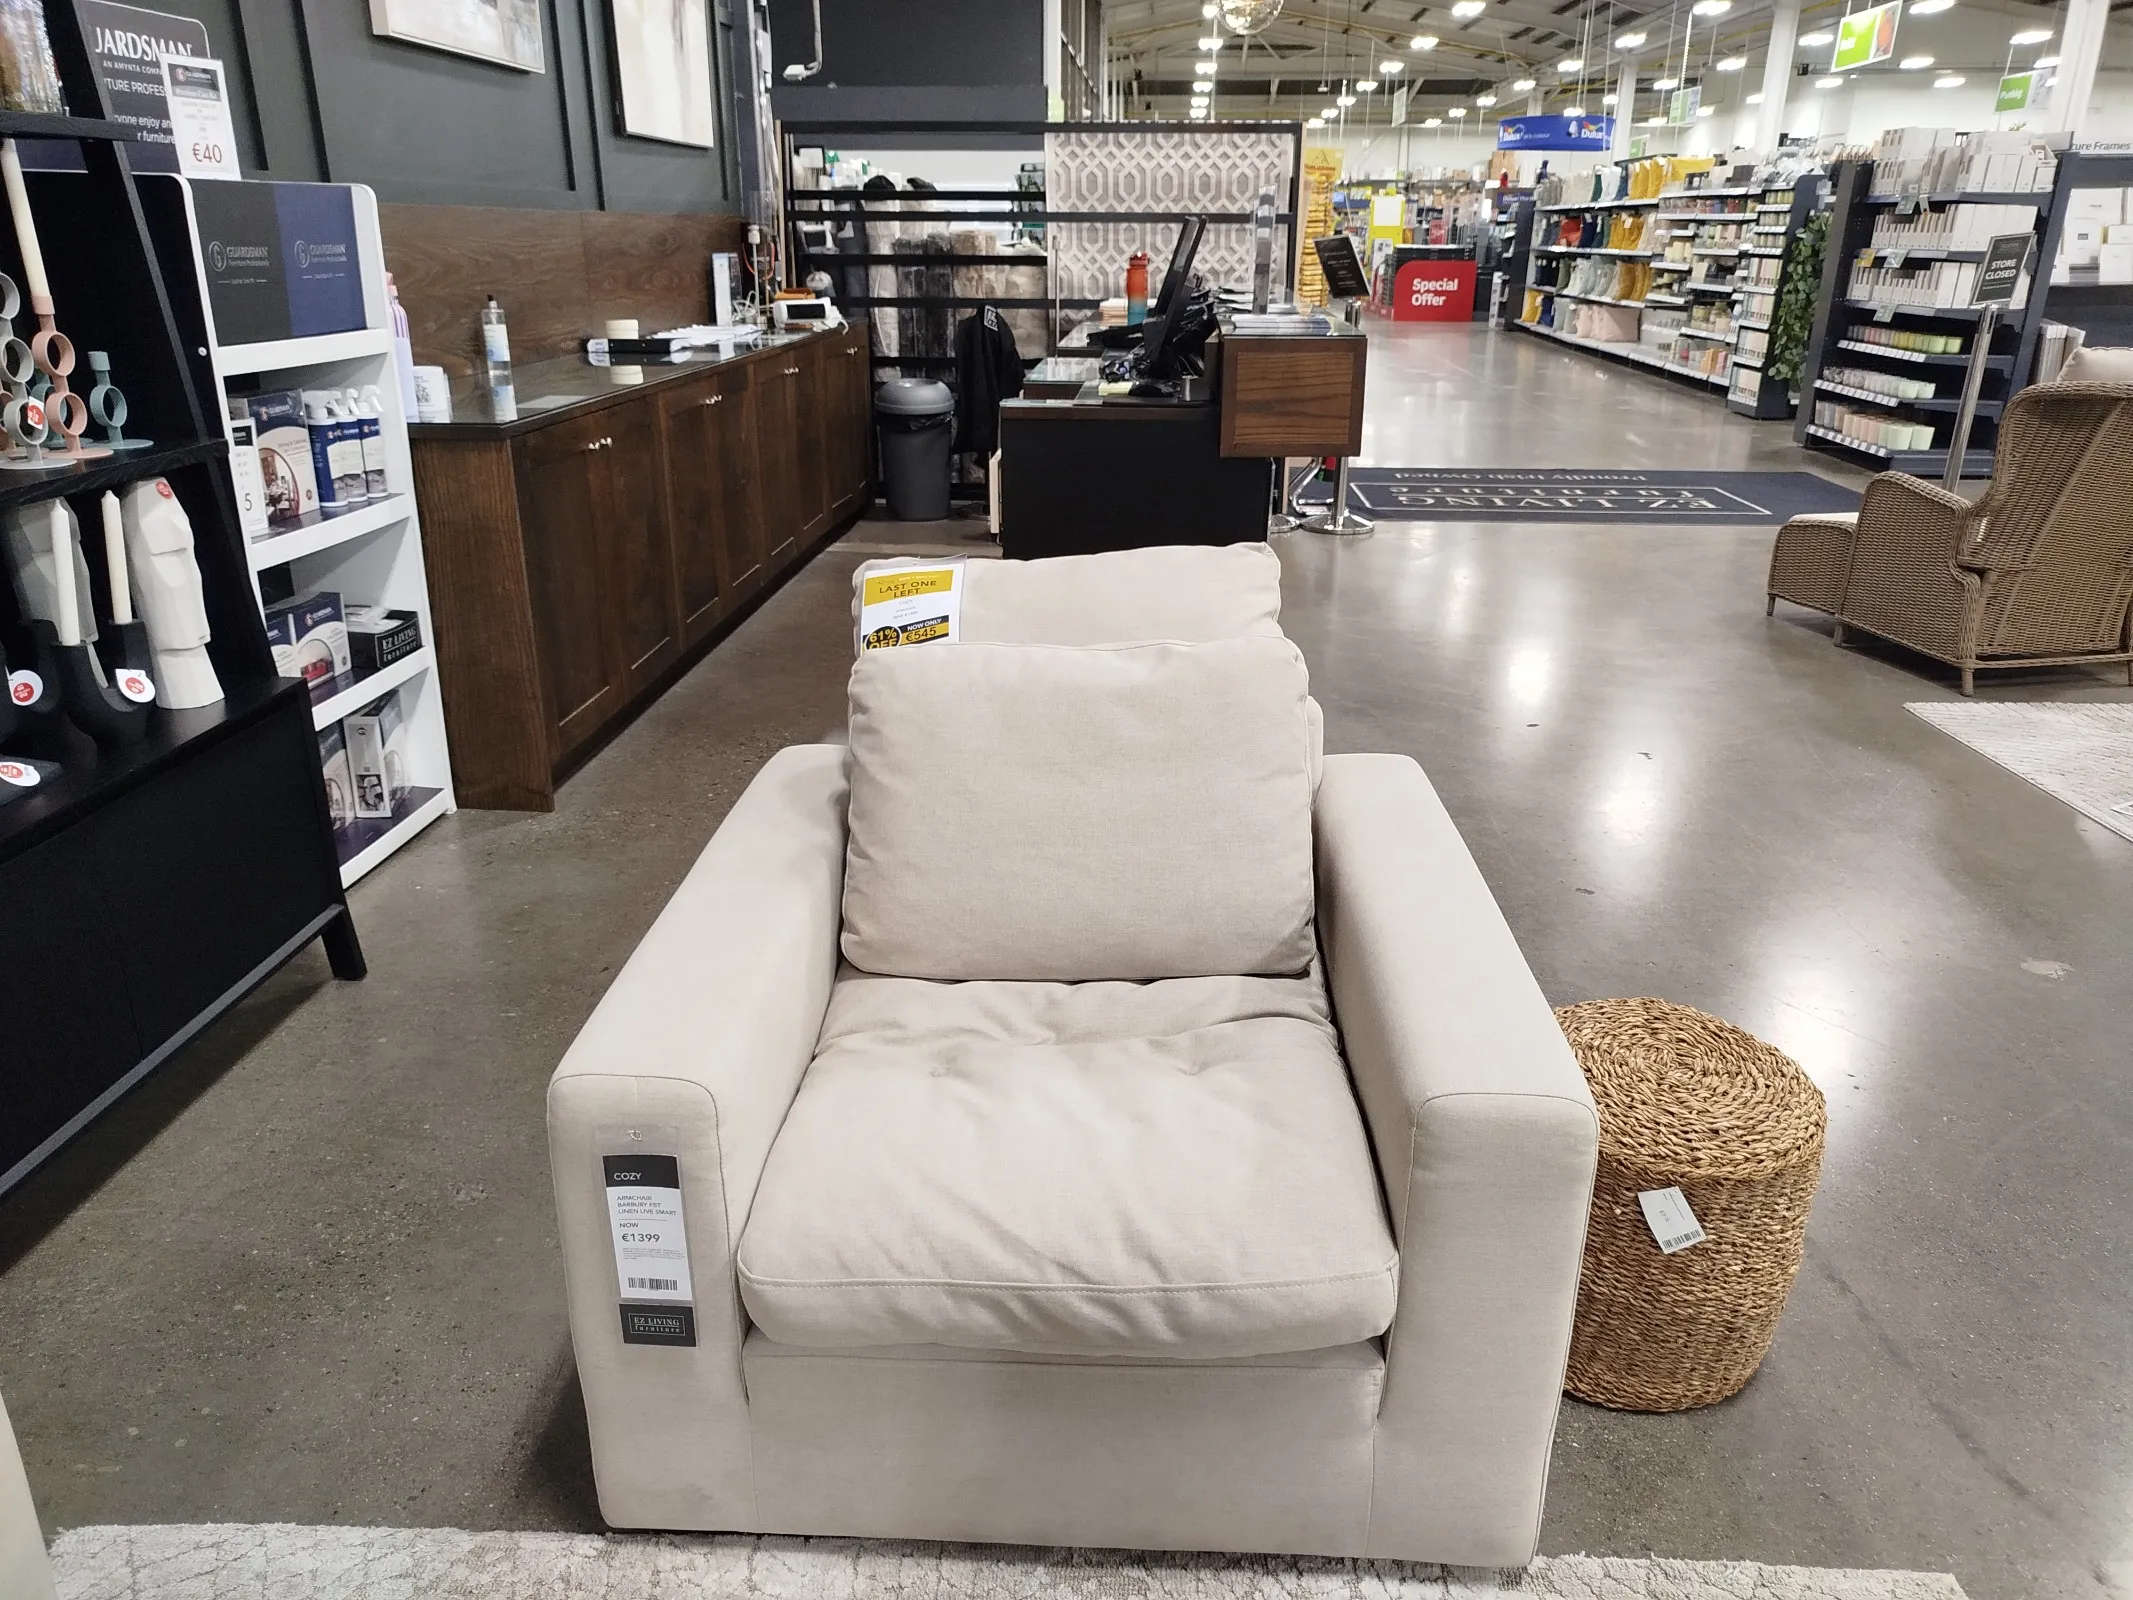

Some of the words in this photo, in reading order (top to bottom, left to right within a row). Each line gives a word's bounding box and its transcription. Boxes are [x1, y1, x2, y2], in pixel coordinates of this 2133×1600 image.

[103, 60, 113, 69] AN
[114, 61, 140, 73] AMYNTA
[104, 78, 130, 93] TURE
[138, 115, 160, 130] enjoy
[2070, 143, 2092, 151] ture
[2094, 142, 2131, 151] Frames
[192, 143, 222, 163] €40
[1991, 259, 2017, 269] STORE
[1985, 269, 2017, 280] CLOSED
[1412, 278, 1459, 292] Special
[1411, 293, 1447, 306] Offer
[1398, 496, 1618, 508] LIVING
[1638, 499, 1722, 509] EZ
[879, 583, 908, 594] LAST
[910, 580, 937, 588] ONE
[893, 588, 921, 598] LEFT
[907, 622, 924, 631] NOW
[924, 618, 942, 627] ONLY
[869, 628, 897, 643] 61%
[906, 626, 937, 642] €545
[869, 640, 897, 650] OFF
[613, 1172, 642, 1180] COZY
[621, 1233, 660, 1243] €1399
[634, 1316, 645, 1324] EZ
[648, 1317, 680, 1326] LIVING
[634, 1325, 680, 1333] furniture
